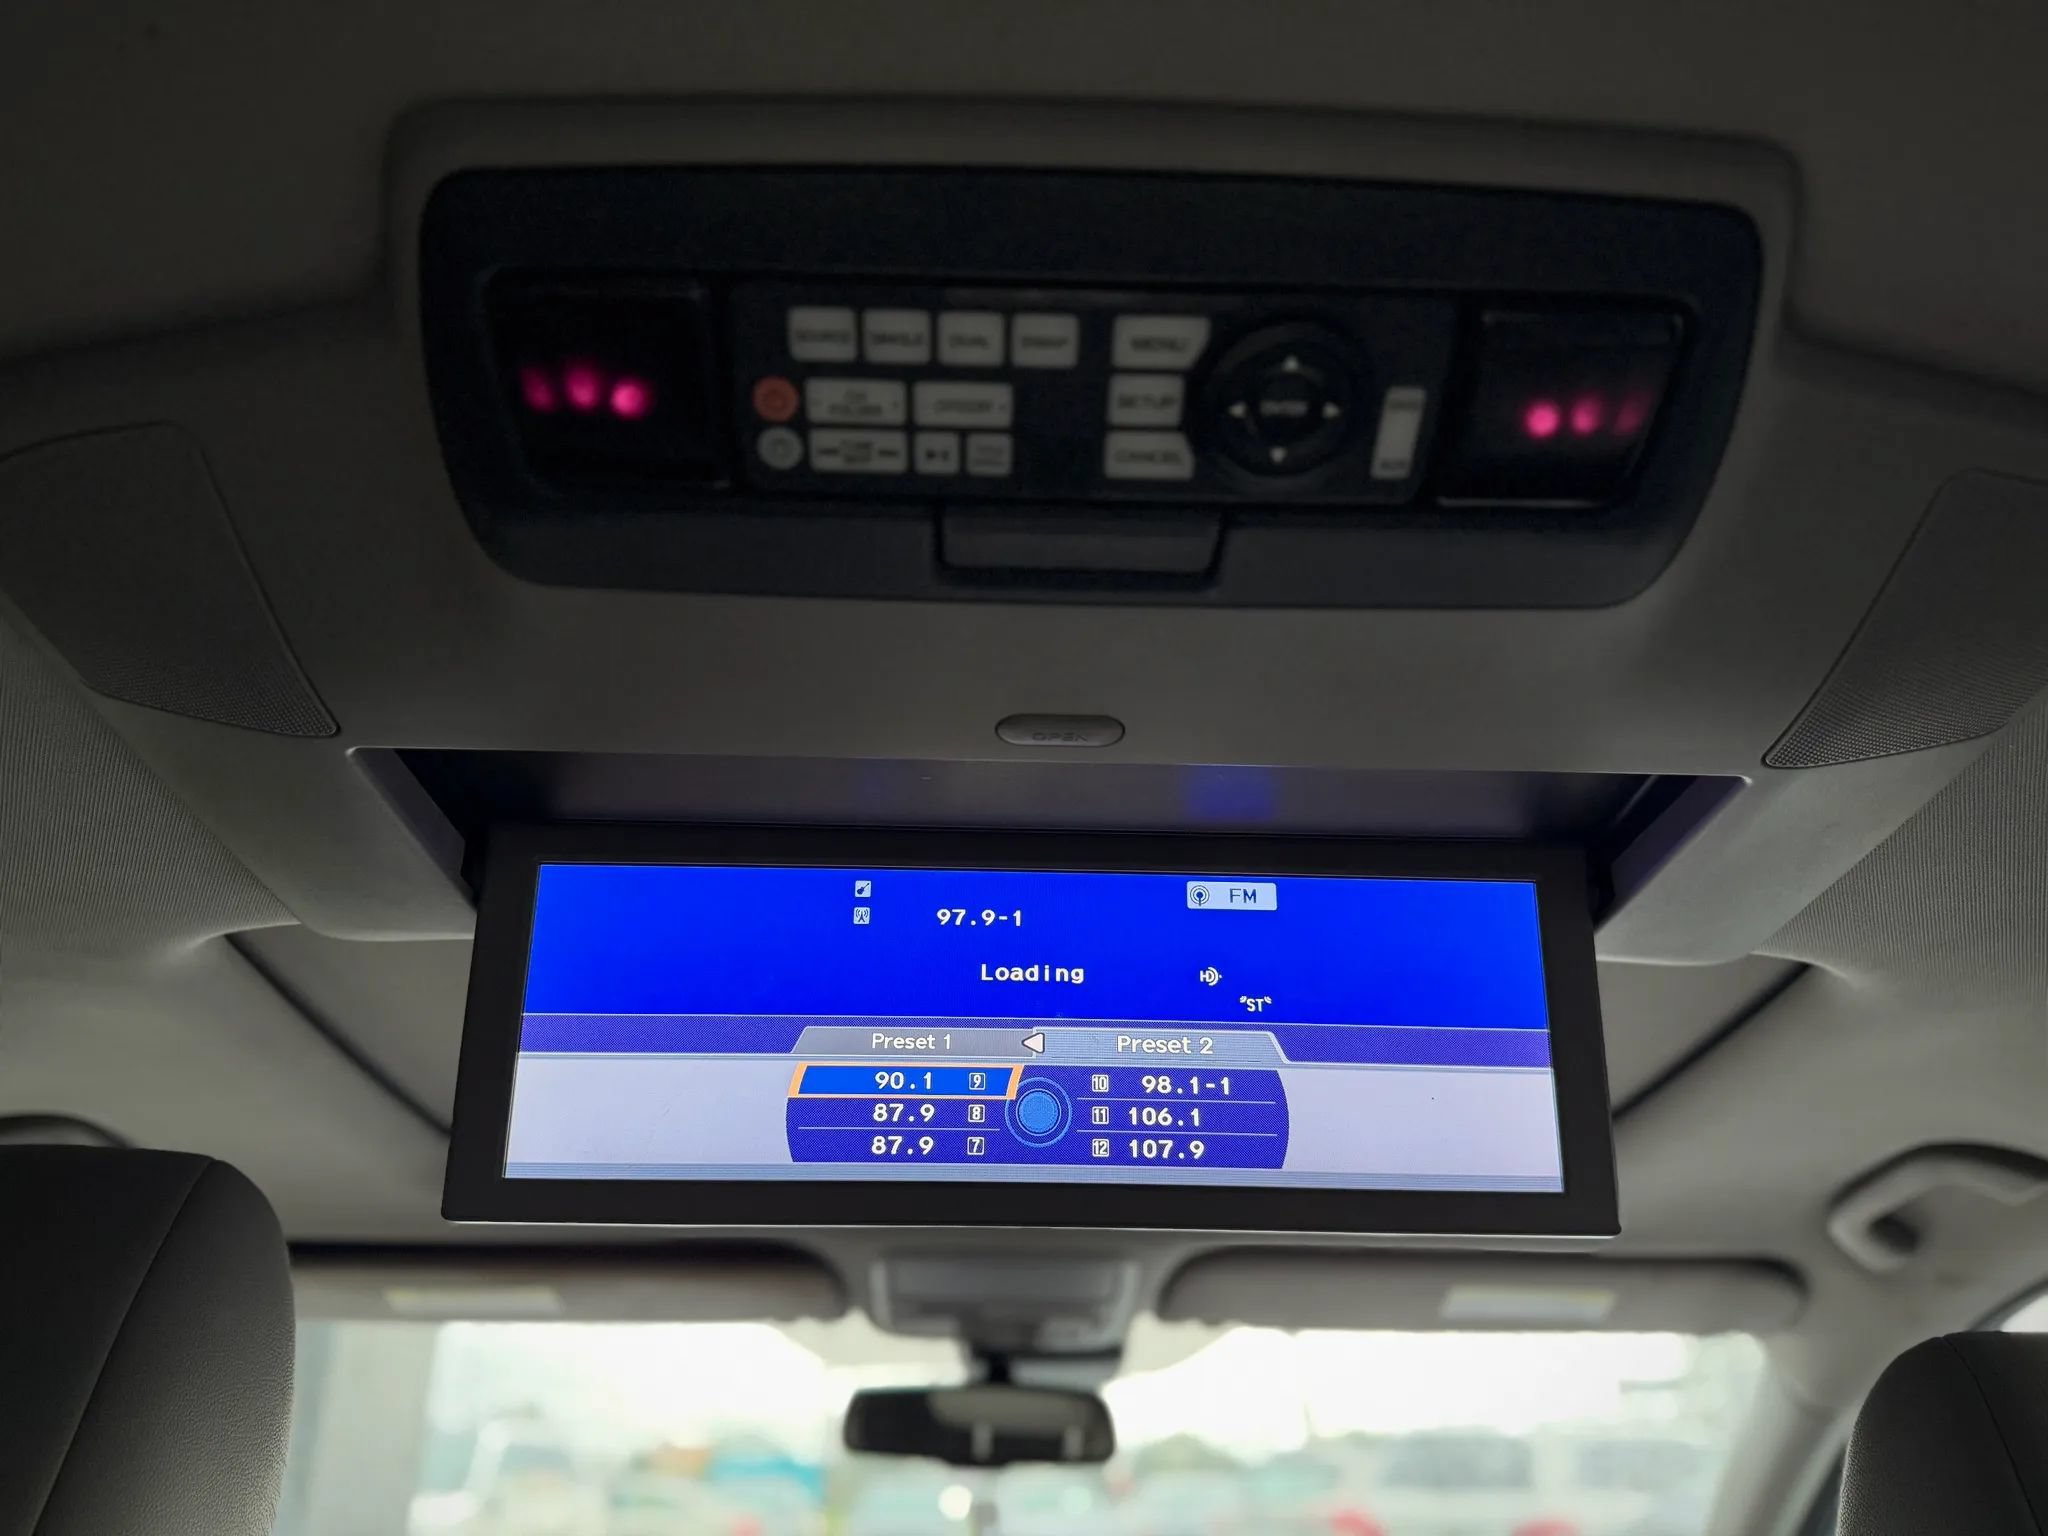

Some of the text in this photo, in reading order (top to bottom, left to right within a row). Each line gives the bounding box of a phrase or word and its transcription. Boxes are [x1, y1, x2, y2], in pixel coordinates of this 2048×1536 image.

[1130, 336, 1191, 352] MENU
[1118, 394, 1177, 409] SETUP
[1115, 450, 1182, 464] CANCEL
[1032, 731, 1089, 743] OPEN
[1230, 889, 1257, 904] FM
[936, 908, 1023, 928] 97.9-1
[980, 963, 1086, 985] Loading
[871, 1033, 952, 1051] Preset 1
[1116, 1036, 1214, 1055] Preset 2
[874, 1072, 935, 1091] 90.1
[1093, 1075, 1231, 1095] 10 98.1-1
[872, 1104, 936, 1123] 87.9
[1093, 1107, 1201, 1127] 11 106.1
[871, 1136, 935, 1156] 87.9
[1093, 1140, 1205, 1160] 12 107.9
